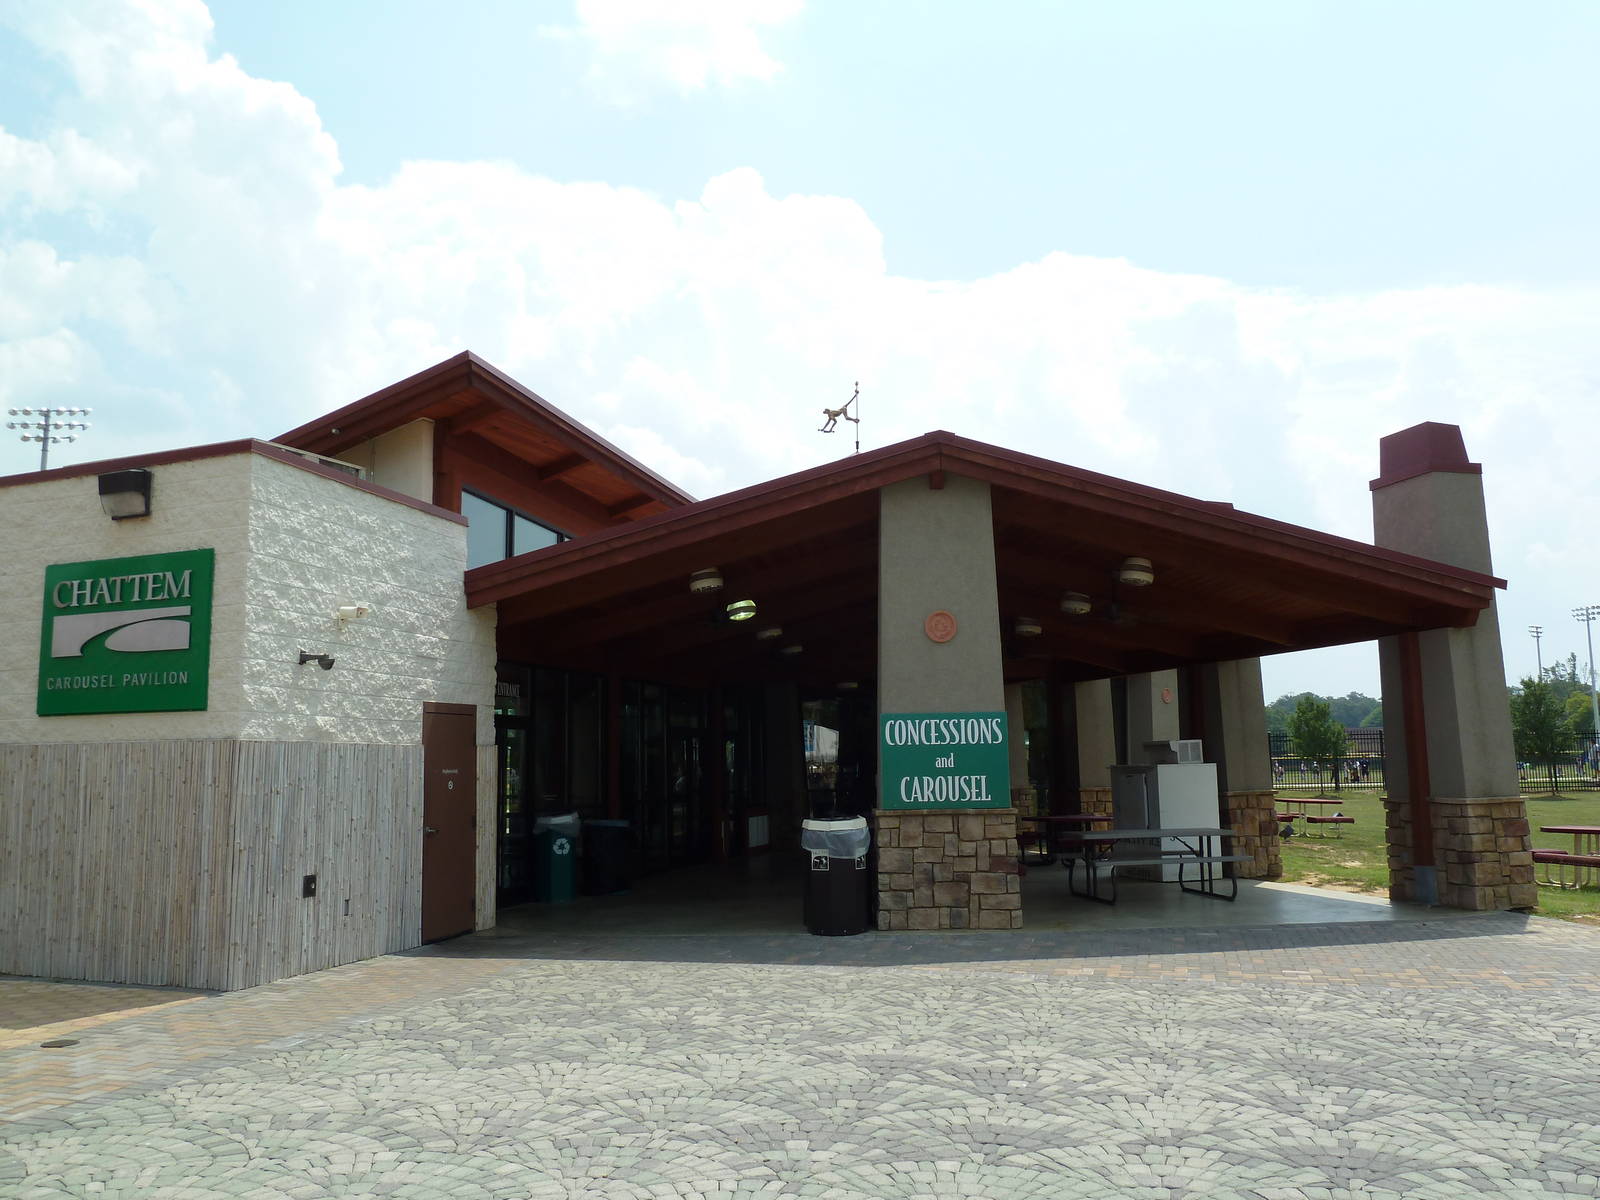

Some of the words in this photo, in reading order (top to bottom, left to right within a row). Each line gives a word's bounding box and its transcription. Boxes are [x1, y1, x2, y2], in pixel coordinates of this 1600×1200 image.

[53, 569, 192, 608] CHATTEM
[46, 674, 116, 690] CAROUSEL
[122, 671, 188, 687] PAVILION
[885, 718, 1003, 745] CONCESSIONS
[935, 752, 955, 768] and
[900, 775, 991, 802] CAROUSEL
